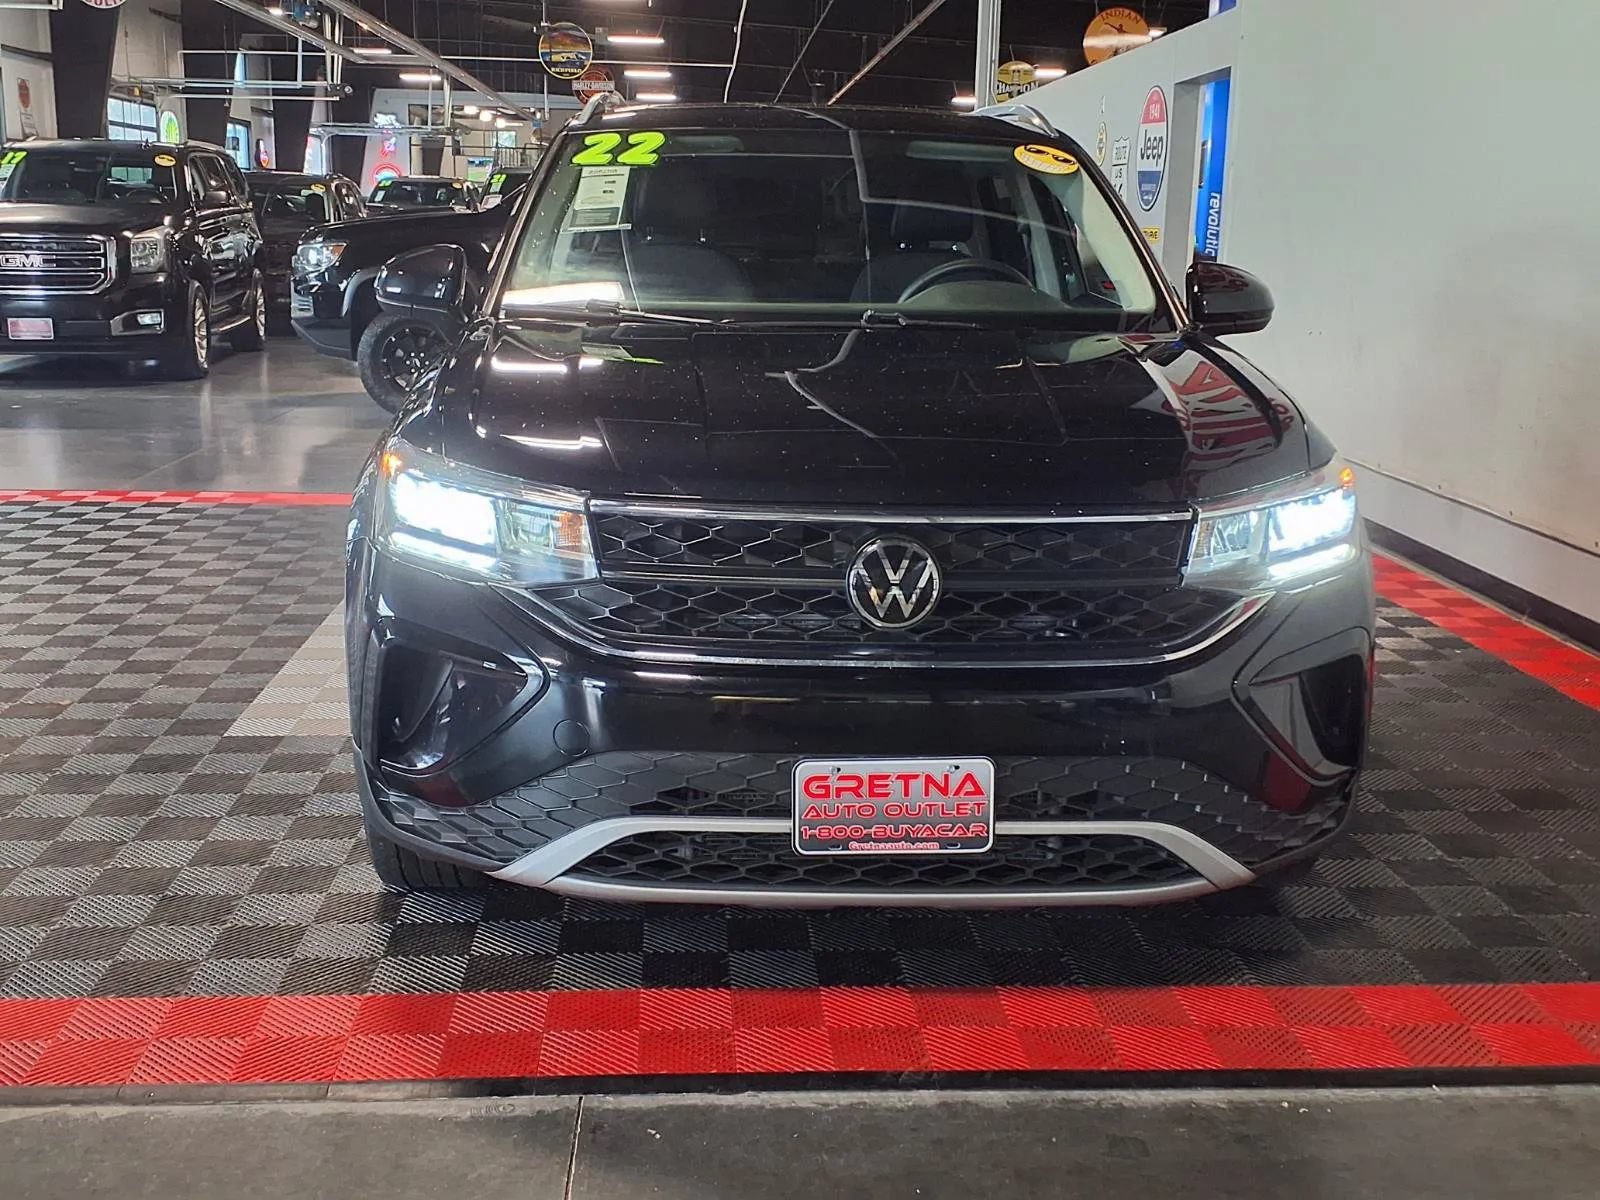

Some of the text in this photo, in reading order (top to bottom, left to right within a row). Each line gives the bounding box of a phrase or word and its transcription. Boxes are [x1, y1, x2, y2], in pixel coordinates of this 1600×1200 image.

[1101, 9, 1141, 25] INDIAN
[571, 131, 666, 165] 22
[1140, 129, 1164, 167] Jeep
[1, 254, 56, 267] GMC
[802, 772, 987, 800] GRETNA
[802, 802, 987, 819] AUTO OUTLET
[801, 823, 988, 839] 1-800-BUYACAR
